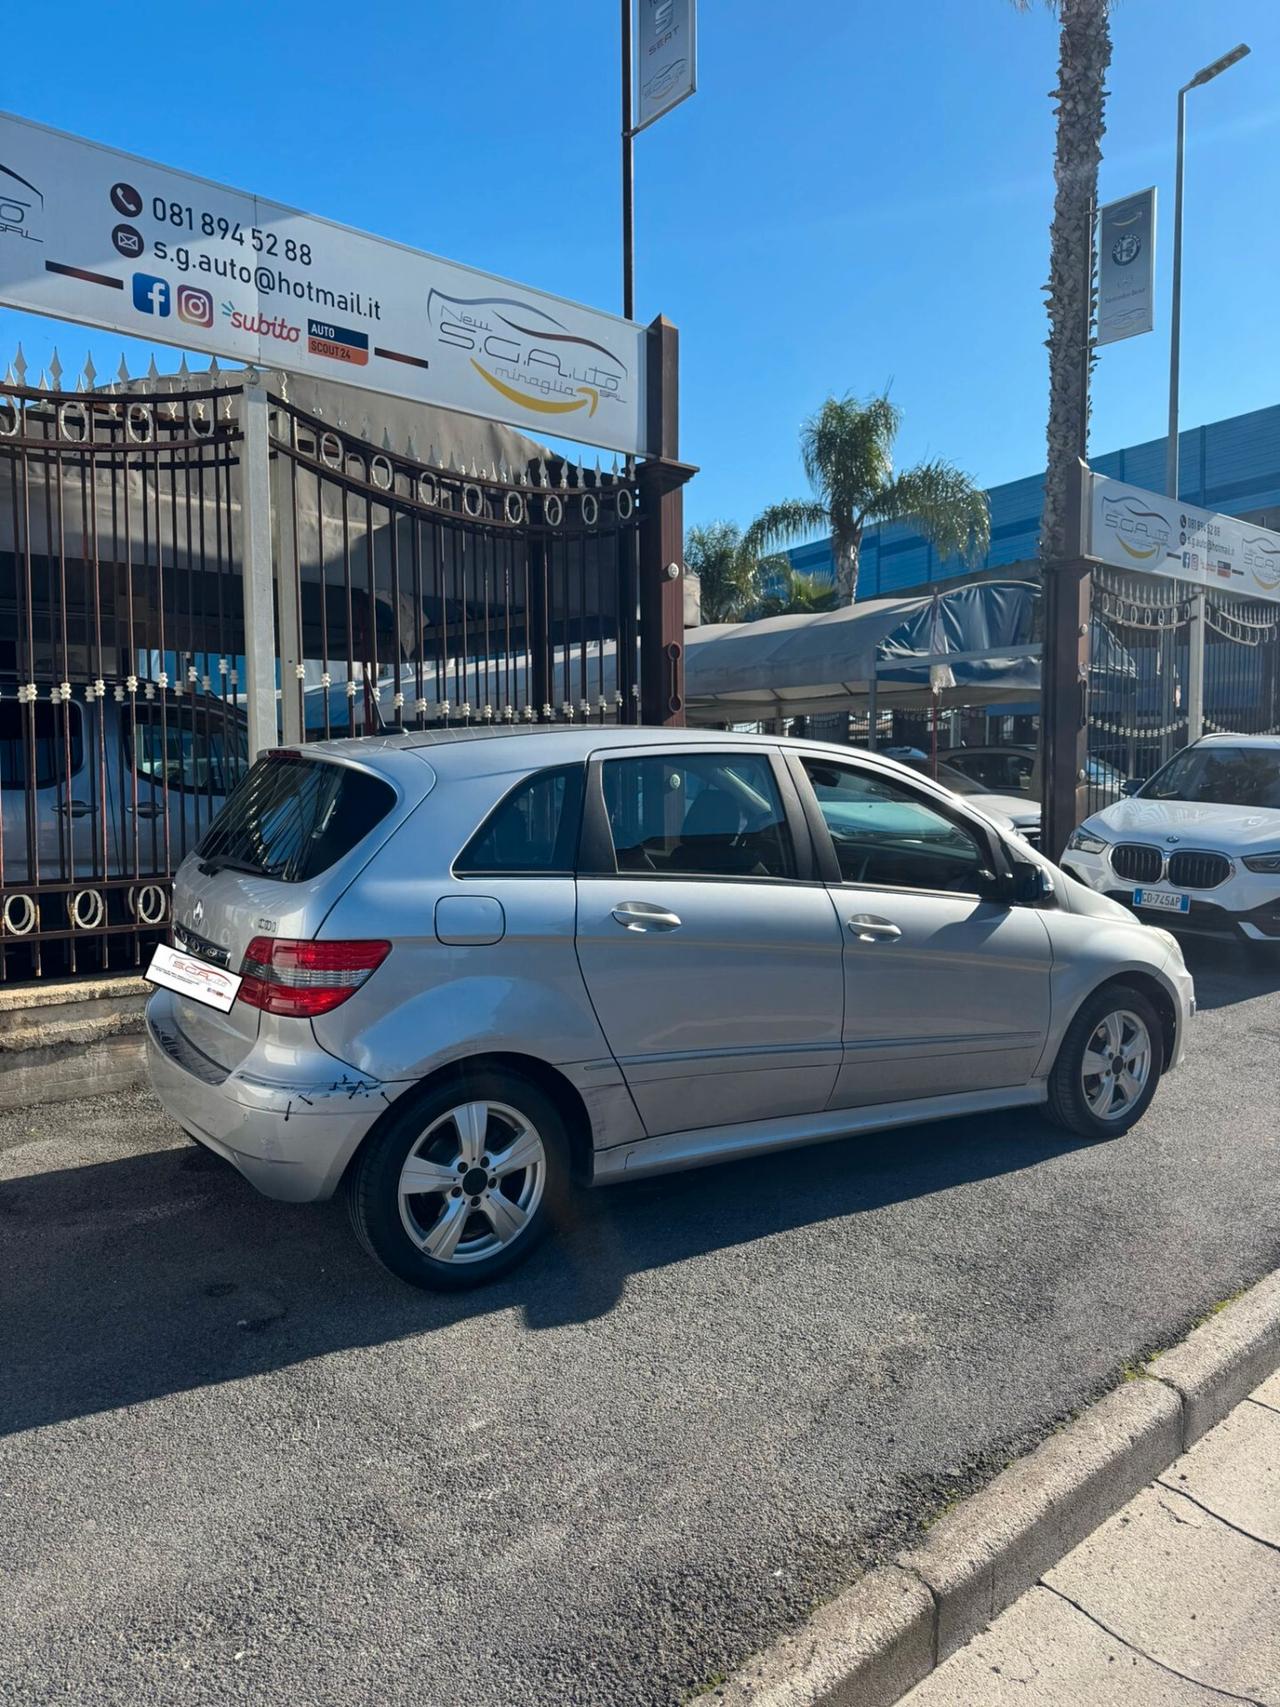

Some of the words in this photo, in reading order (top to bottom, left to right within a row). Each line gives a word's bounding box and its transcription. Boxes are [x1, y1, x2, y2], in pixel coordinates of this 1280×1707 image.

[152, 196, 194, 230] 081
[201, 212, 245, 246] 894
[251, 227, 278, 257] 52
[284, 239, 312, 266] 88
[153, 241, 381, 320] s.g.auto@hotmail.it
[230, 311, 301, 343] subito
[311, 323, 335, 338] AUTO
[440, 305, 493, 332] New
